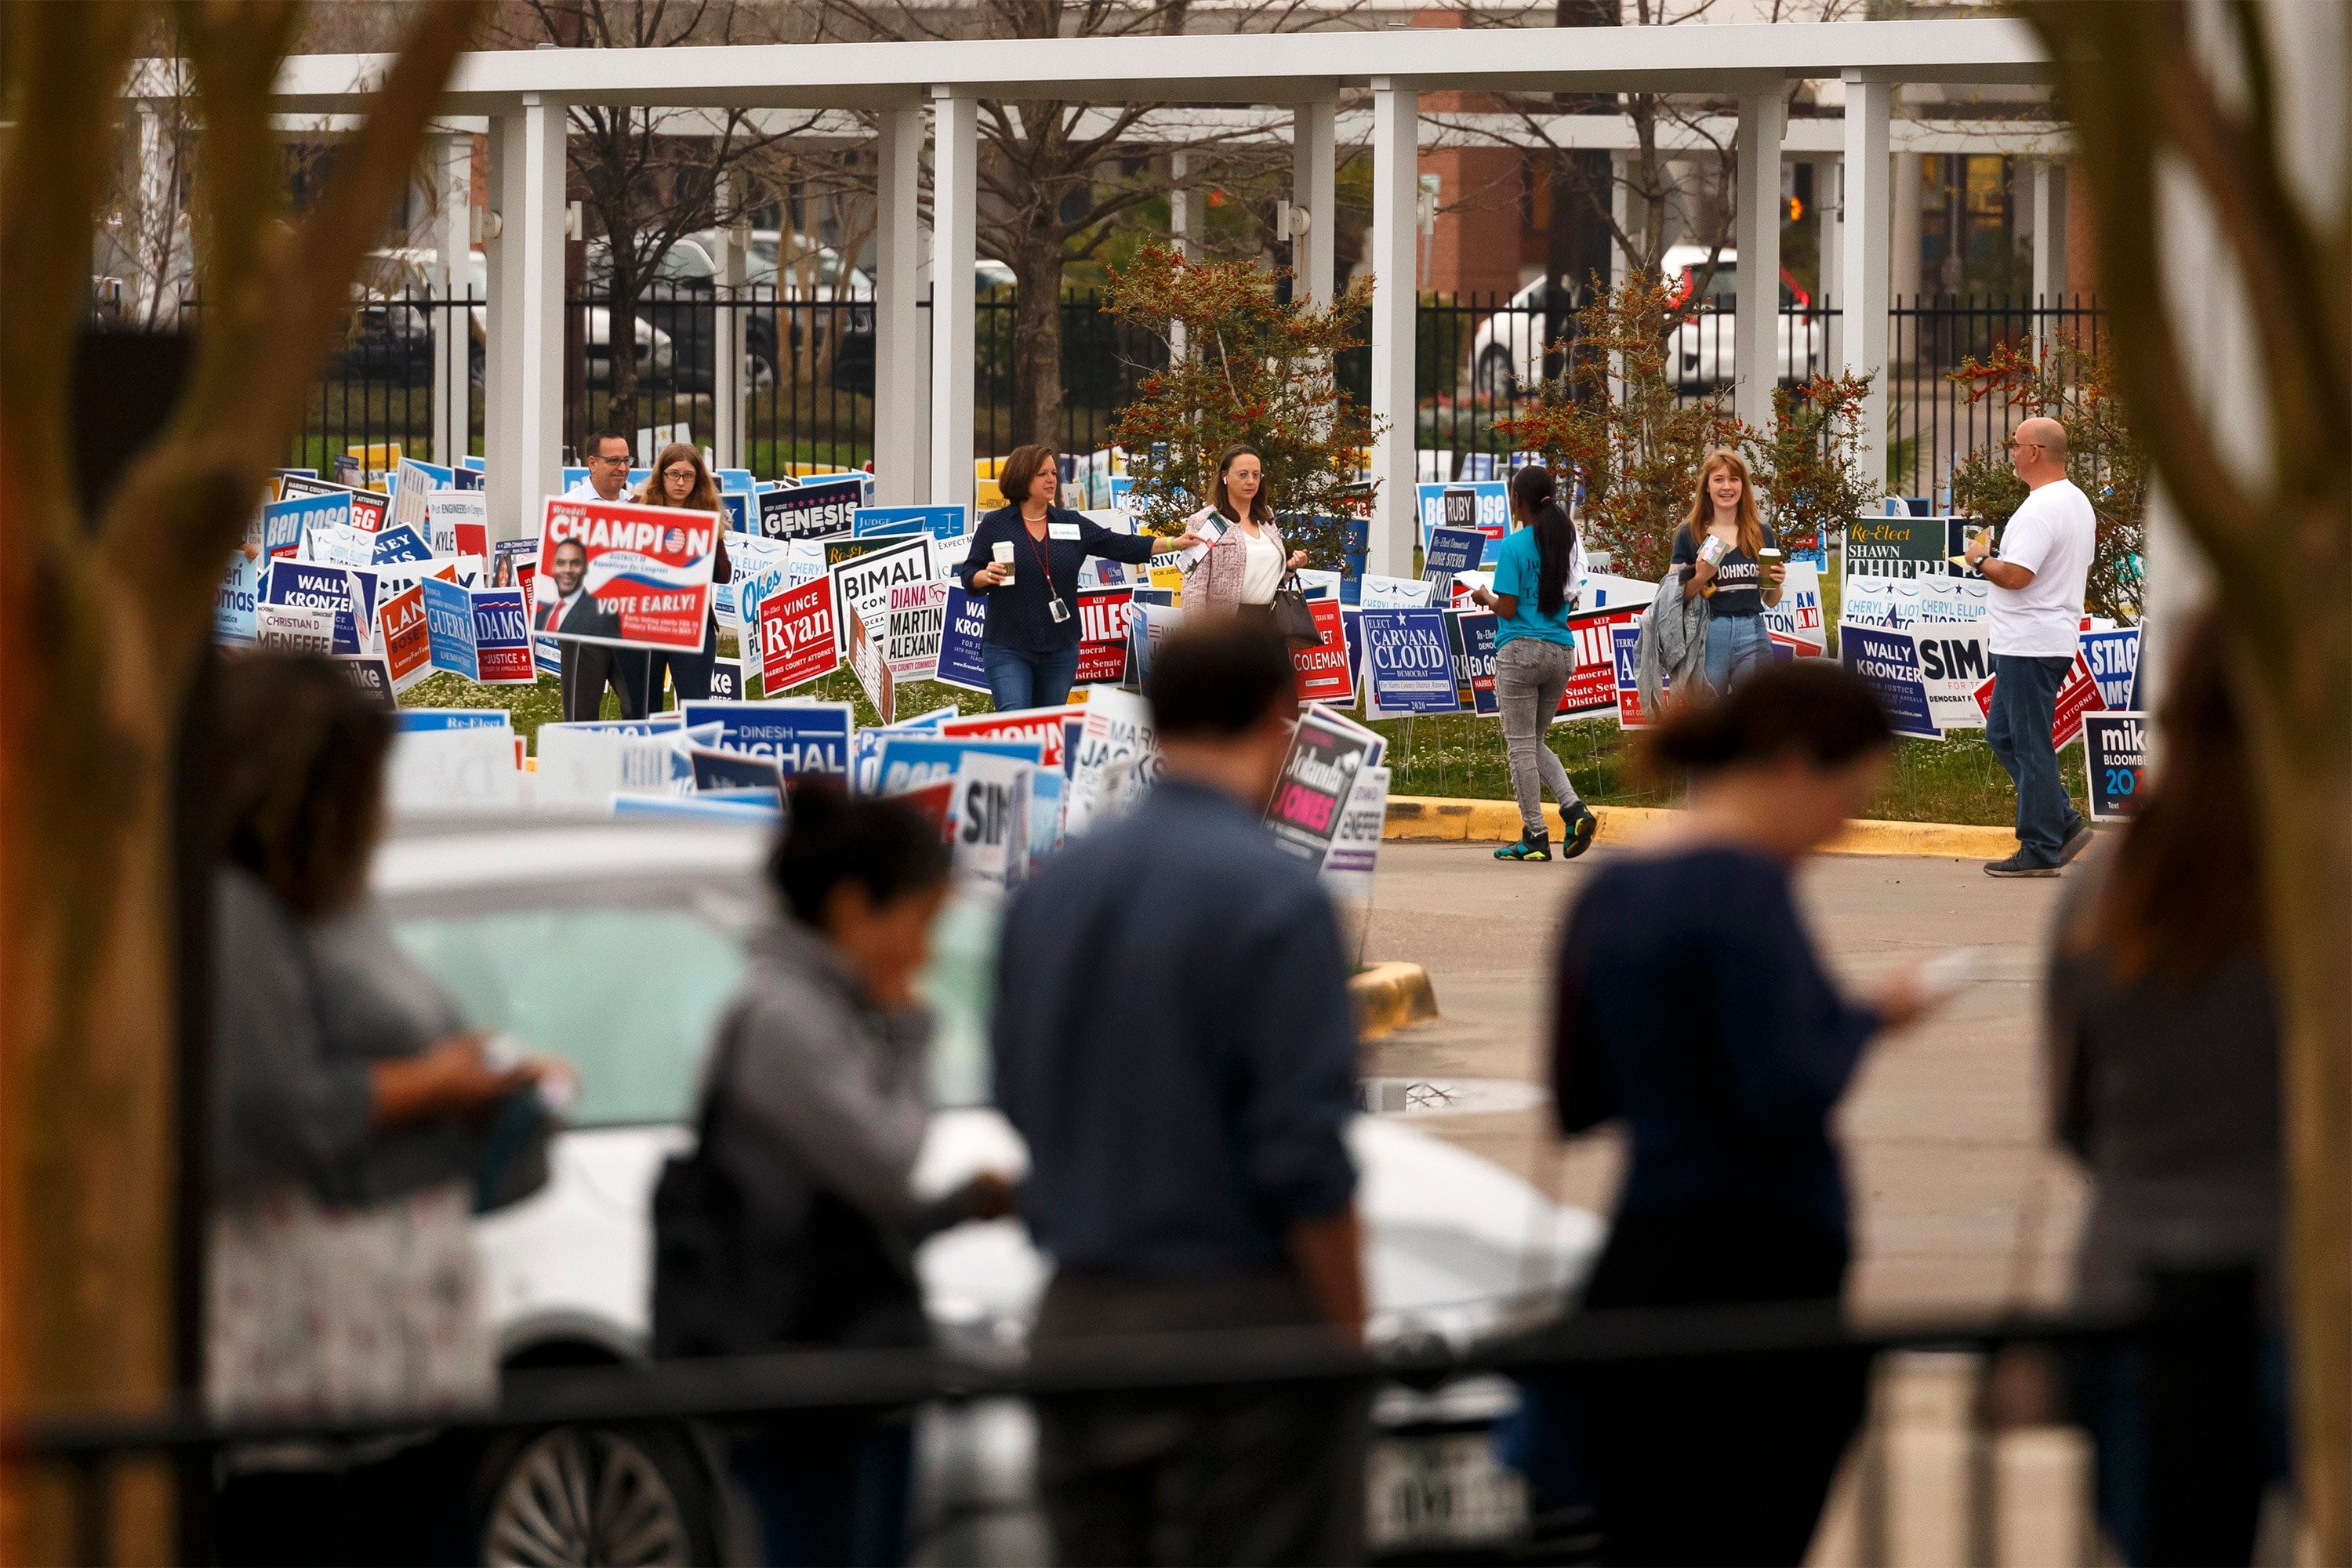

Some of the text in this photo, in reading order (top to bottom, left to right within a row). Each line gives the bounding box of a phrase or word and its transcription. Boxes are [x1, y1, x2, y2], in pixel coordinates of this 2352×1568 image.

[357, 495, 384, 506] ATTORNEY
[442, 504, 466, 514] ENGINEERS
[1446, 496, 1471, 522] RUBY
[552, 505, 586, 517] Wendell
[765, 501, 858, 535] GENESIS
[266, 512, 299, 547] Ben
[858, 517, 891, 528] JUDGE
[435, 532, 454, 551] KYLE
[550, 514, 710, 557] CHAMPION
[1851, 522, 1911, 543] Re-Elect
[938, 539, 964, 550] EXPECT
[1849, 544, 1900, 558] SHAWN
[1428, 550, 1467, 568] JUDGE STEVEN
[298, 575, 350, 594] WALLY
[844, 557, 922, 601] BIMAL
[597, 596, 637, 615] VOTE
[641, 594, 696, 612] EARLY!
[742, 569, 782, 624] Okes
[784, 592, 818, 616] VINCE
[891, 584, 927, 609] DIANA
[1847, 599, 1882, 615] CHERYL
[1922, 599, 1954, 615] CHERYL
[267, 615, 312, 630] CHRISTIAN
[427, 608, 474, 645] GUERRA
[889, 607, 942, 637] MARTIN
[1368, 619, 1390, 629] ELECT
[1593, 617, 1610, 626] KEEP
[1762, 614, 1795, 633] TON
[764, 608, 831, 659] Ryan
[1371, 630, 1439, 646] CARVANA
[961, 639, 973, 648] FOR
[1863, 640, 1911, 662] WALLY
[487, 653, 517, 664] JUSTICE
[765, 646, 835, 678] HARRIS COUNTY ATTORNEY
[1093, 659, 1122, 669] Senate
[1294, 650, 1345, 672] COLEMAN
[1374, 645, 1444, 669] CLOUD
[1919, 638, 1995, 681] SIM
[897, 662, 914, 672] COUNTY
[1105, 668, 1115, 677] 13
[1856, 659, 1923, 684] KRONZER
[1400, 681, 1415, 690] County
[1431, 681, 1449, 690] Attorney
[1475, 679, 1492, 688] HARRIS
[1566, 687, 1593, 698] State
[1884, 684, 1914, 695] JUSTICE
[1410, 701, 1426, 710] 2020
[1567, 694, 1608, 707] District
[2063, 689, 2097, 722] ATTORNEY
[740, 724, 794, 740] DINESH
[2101, 719, 2152, 751] mik
